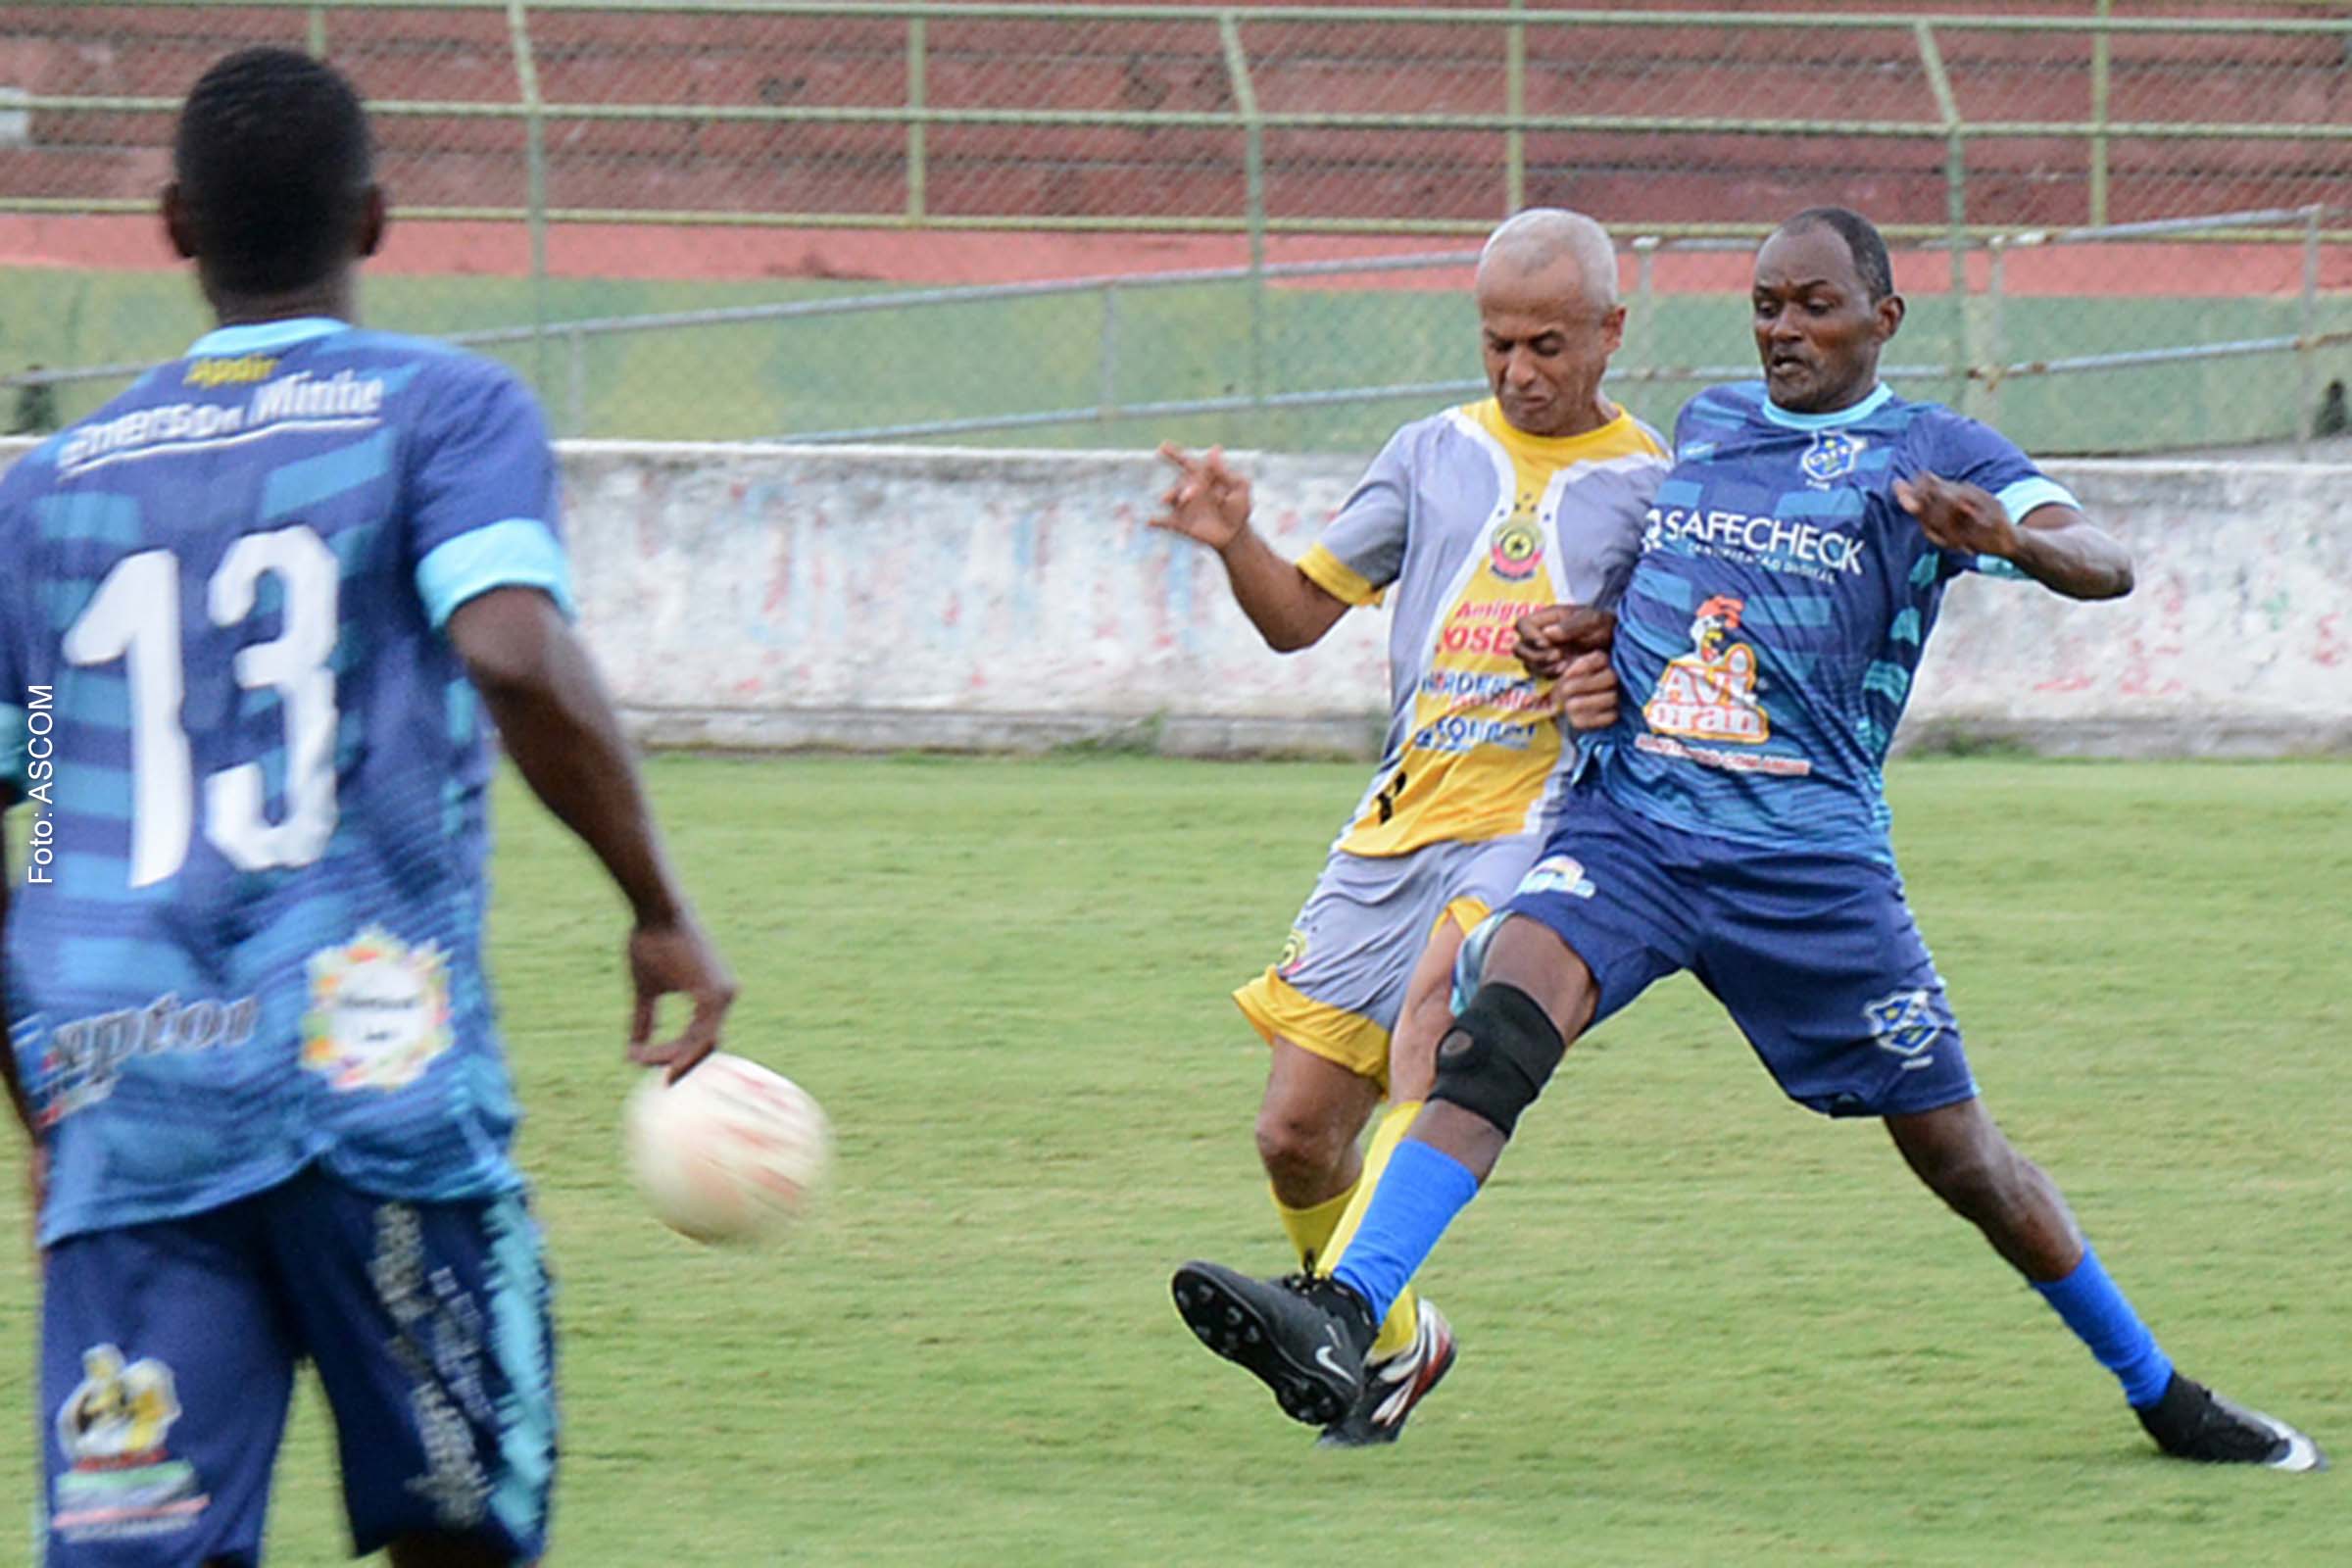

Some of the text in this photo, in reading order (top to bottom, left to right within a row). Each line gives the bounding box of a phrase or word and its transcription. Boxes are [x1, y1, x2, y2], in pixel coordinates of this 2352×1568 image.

[1666, 510, 1864, 575] SAFECHECK
[1435, 626, 1518, 657] OSE
[62, 523, 340, 889] 13
